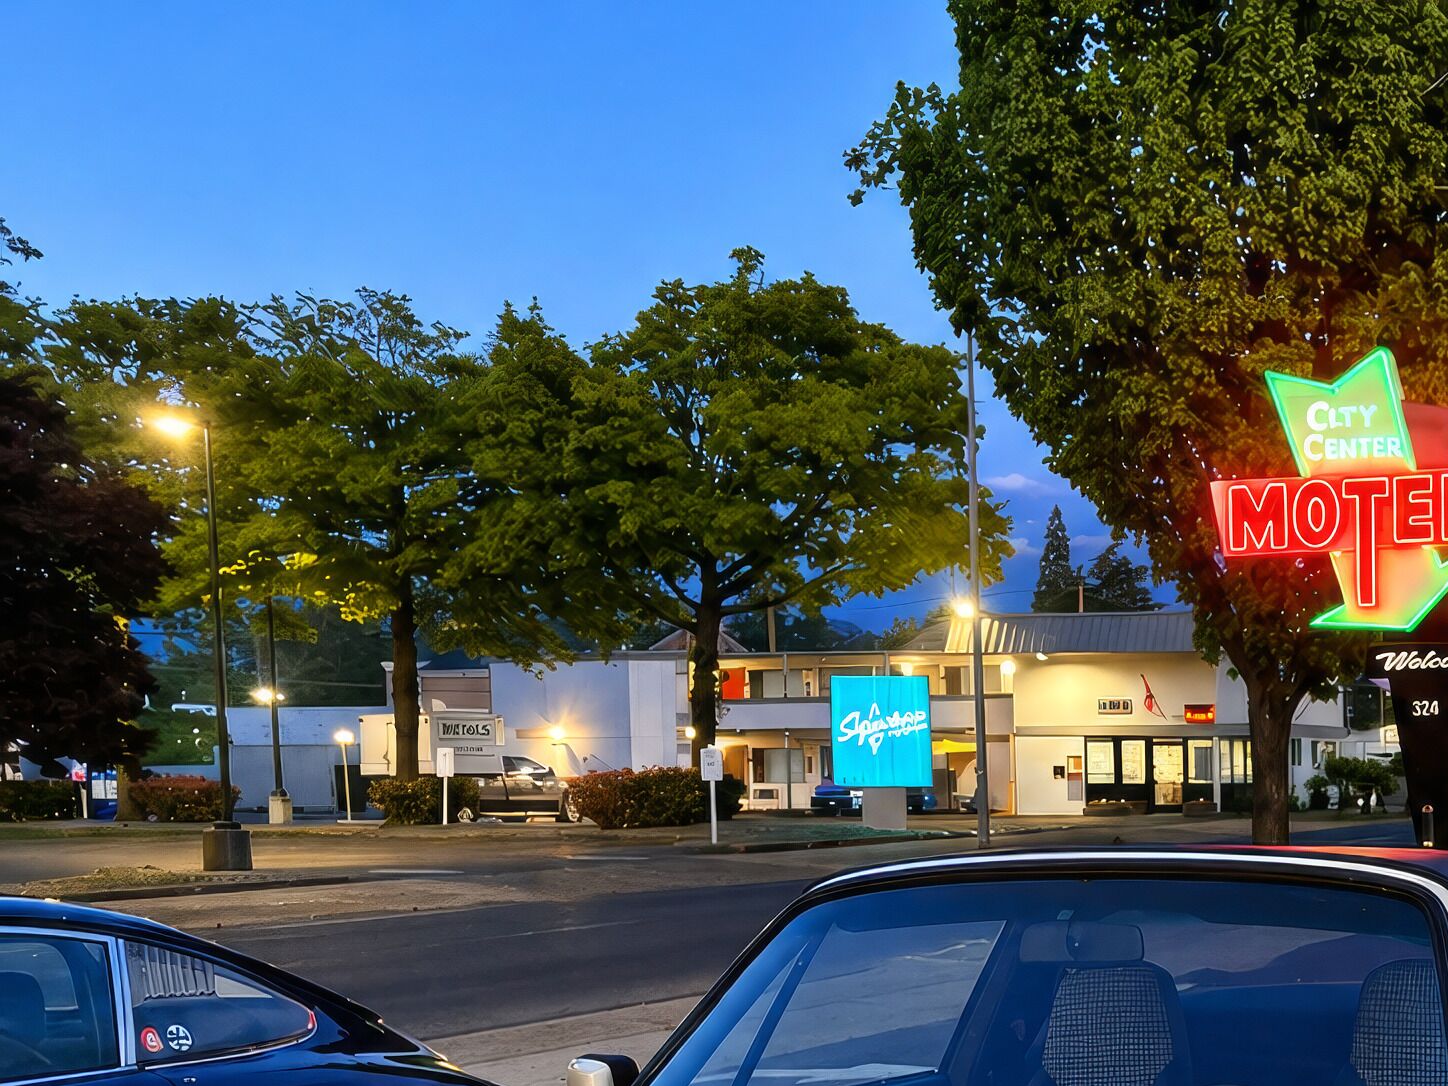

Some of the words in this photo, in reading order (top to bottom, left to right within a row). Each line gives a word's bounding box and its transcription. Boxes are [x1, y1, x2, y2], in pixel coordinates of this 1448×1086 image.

[1306, 401, 1378, 431] CITY
[1303, 434, 1402, 462] CENTER
[1411, 699, 1439, 717] 324
